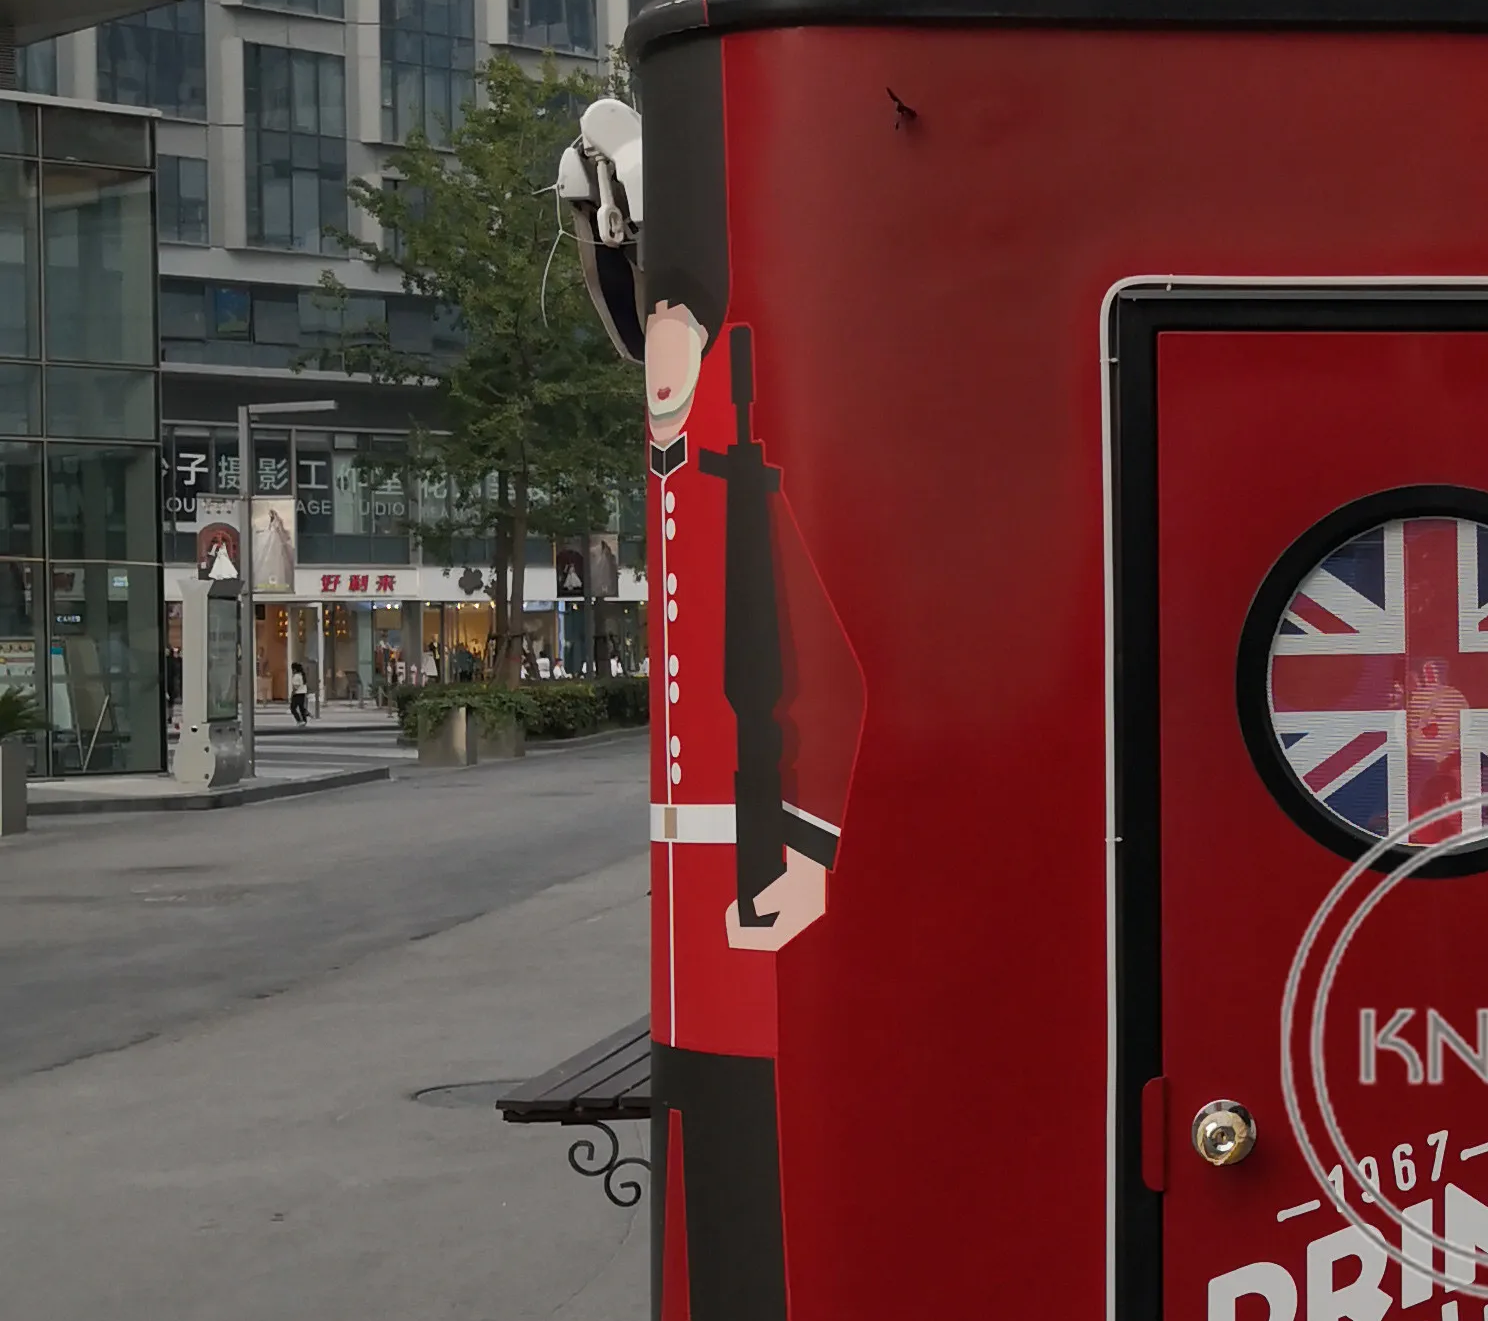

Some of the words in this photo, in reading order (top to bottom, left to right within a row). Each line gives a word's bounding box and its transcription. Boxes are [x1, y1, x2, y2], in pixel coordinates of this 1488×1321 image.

[161, 453, 404, 495] 子摄影工作室
[320, 574, 396, 593] 好利来
[1327, 1129, 1449, 1214] 1967
